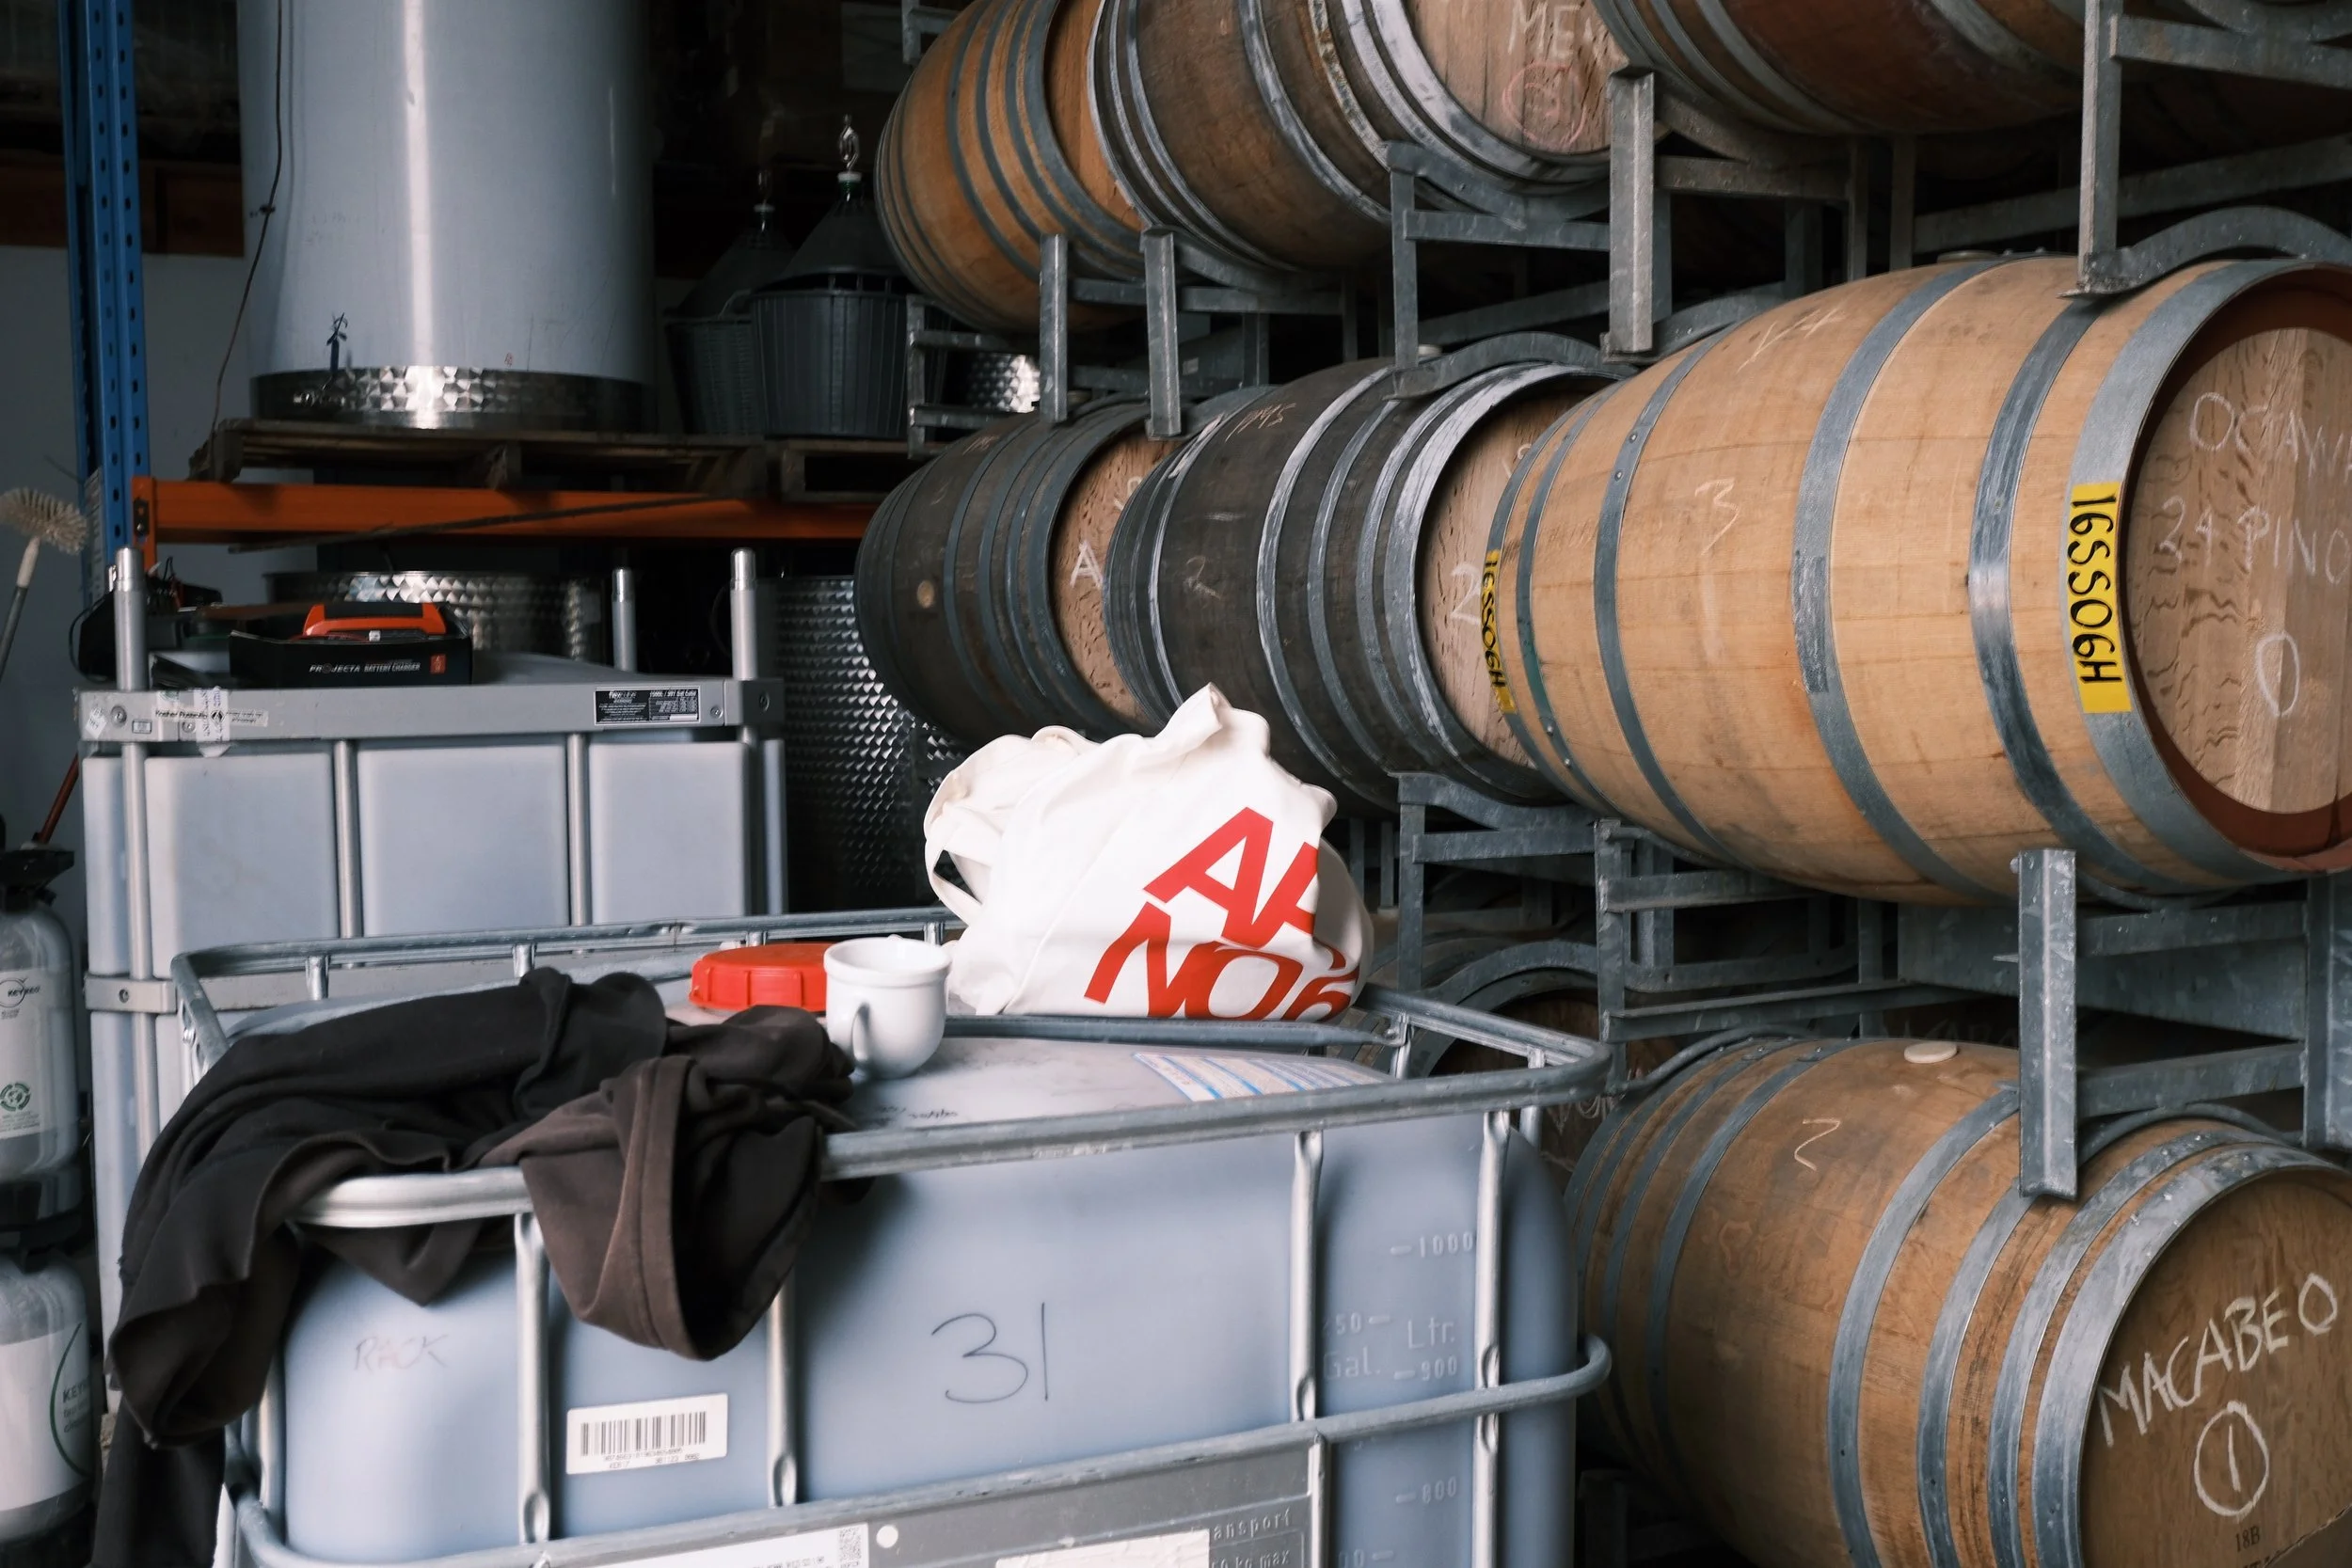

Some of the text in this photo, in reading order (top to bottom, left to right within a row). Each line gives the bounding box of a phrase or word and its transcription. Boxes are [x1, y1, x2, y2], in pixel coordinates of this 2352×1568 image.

[1694, 477, 1740, 555] 3
[309, 664, 361, 673] PROJECTA
[1419, 1231, 1473, 1258] 1000
[1407, 1317, 1456, 1349] Ltr.
[931, 1302, 1049, 1402] 31
[2099, 1273, 2338, 1447] MACABEO
[1210, 1507, 1293, 1541] ansport
[2235, 1526, 2261, 1553] 18B
